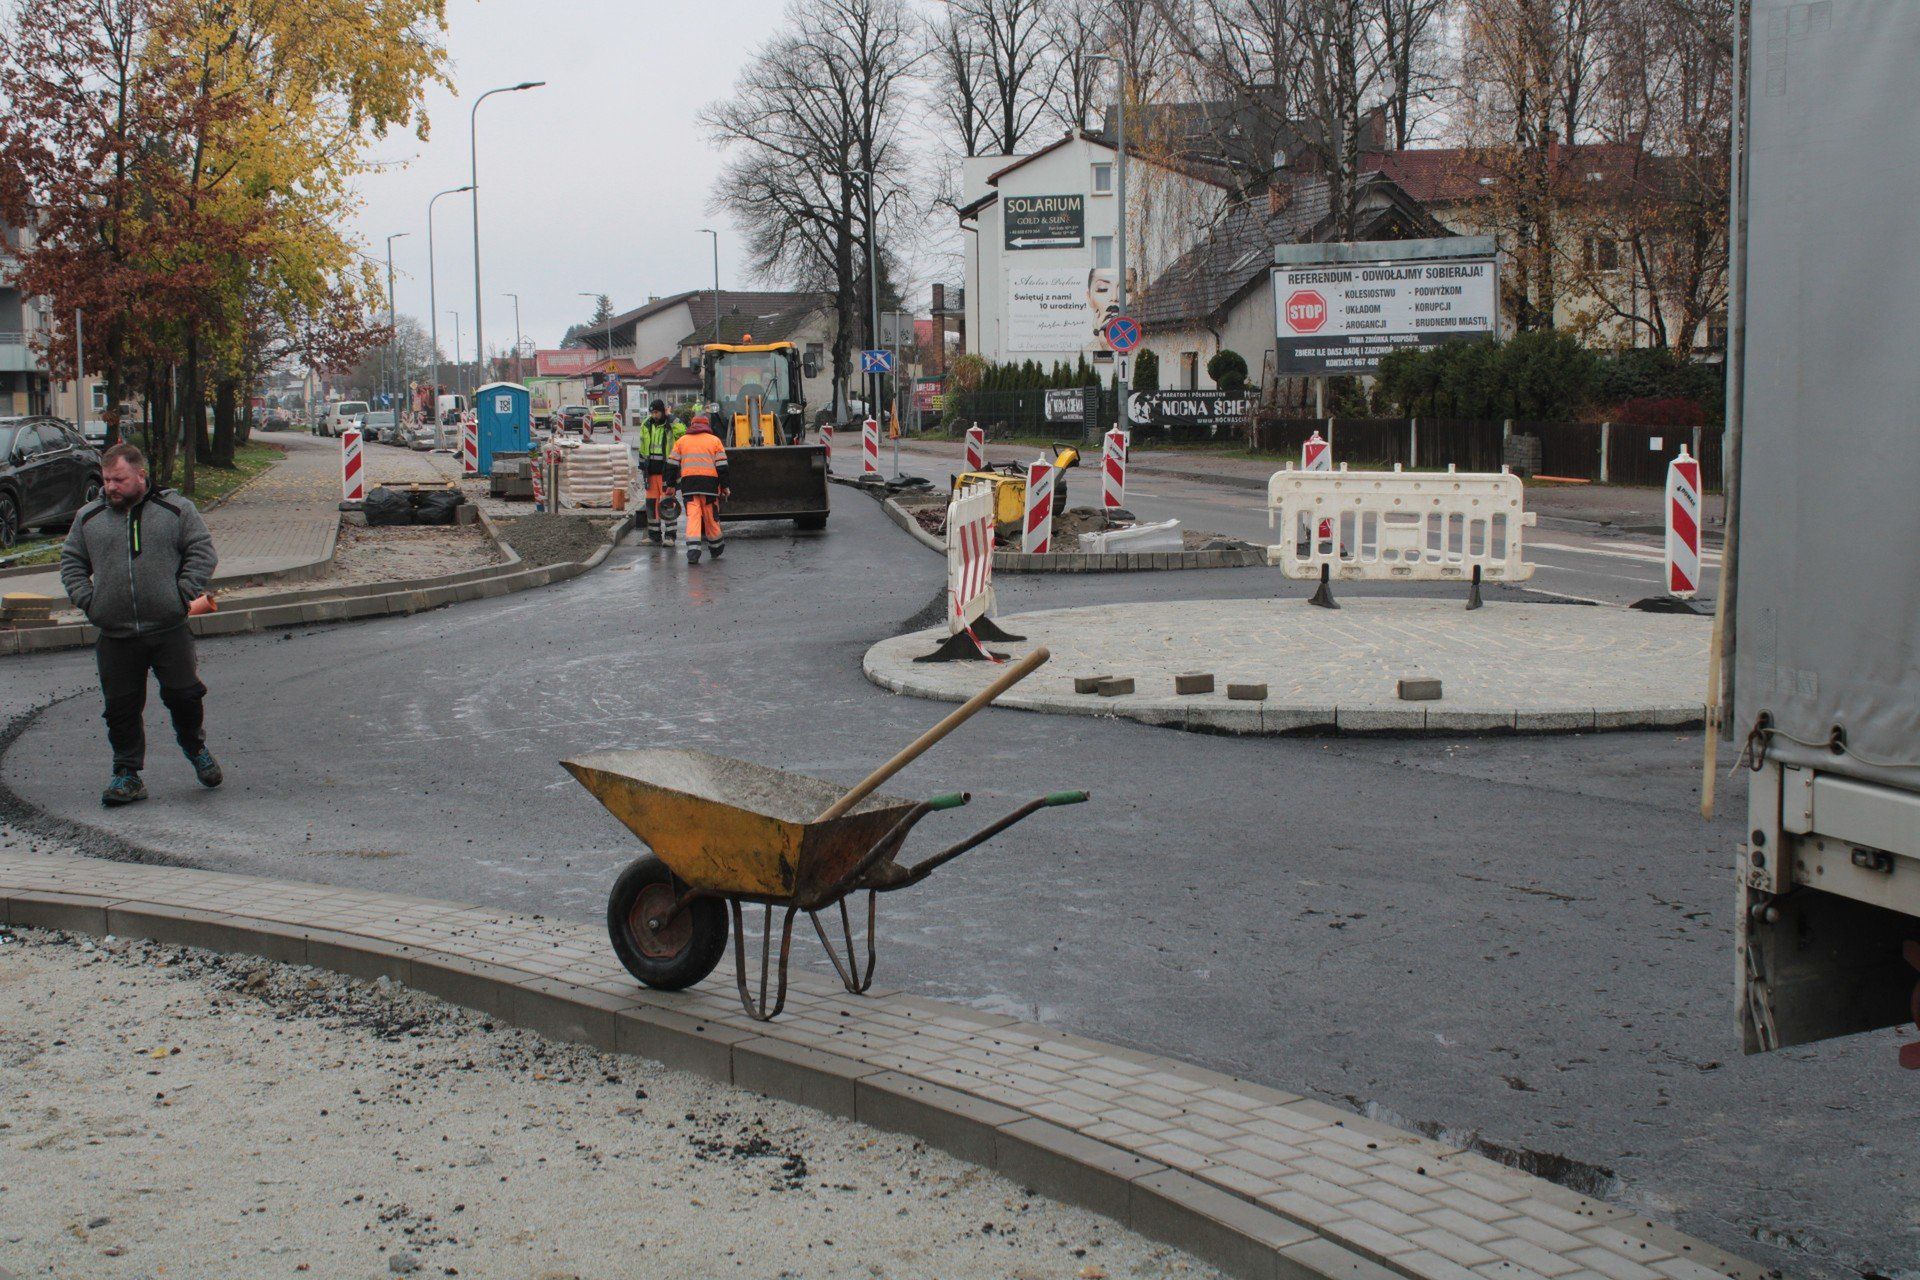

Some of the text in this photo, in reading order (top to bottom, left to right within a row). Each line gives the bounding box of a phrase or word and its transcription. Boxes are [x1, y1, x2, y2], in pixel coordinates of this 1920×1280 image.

[1007, 198, 1080, 213] SOLARIUM
[1288, 272, 1352, 285] REFERENDUM
[1362, 268, 1423, 282] ODWOŁAJMY
[1426, 266, 1484, 279] SOBIERAJA!
[1345, 288, 1396, 299] KOLESIOSTWU
[1414, 286, 1462, 296] PODWYŻKOM
[1014, 293, 1044, 302] Świętuj
[1289, 304, 1323, 319] STOP
[1345, 305, 1381, 315] UKŁADOM
[1415, 302, 1451, 312] KORUPCJI
[1345, 320, 1387, 330] AROGANCJI
[1415, 316, 1487, 328] BRUDNEMU MIASTU
[1294, 348, 1316, 357] ZBIERZ
[1316, 348, 1326, 356] ILE
[1327, 348, 1343, 356] DASZ
[1343, 347, 1360, 357] RADĘ
[1162, 400, 1208, 416] NOCNA
